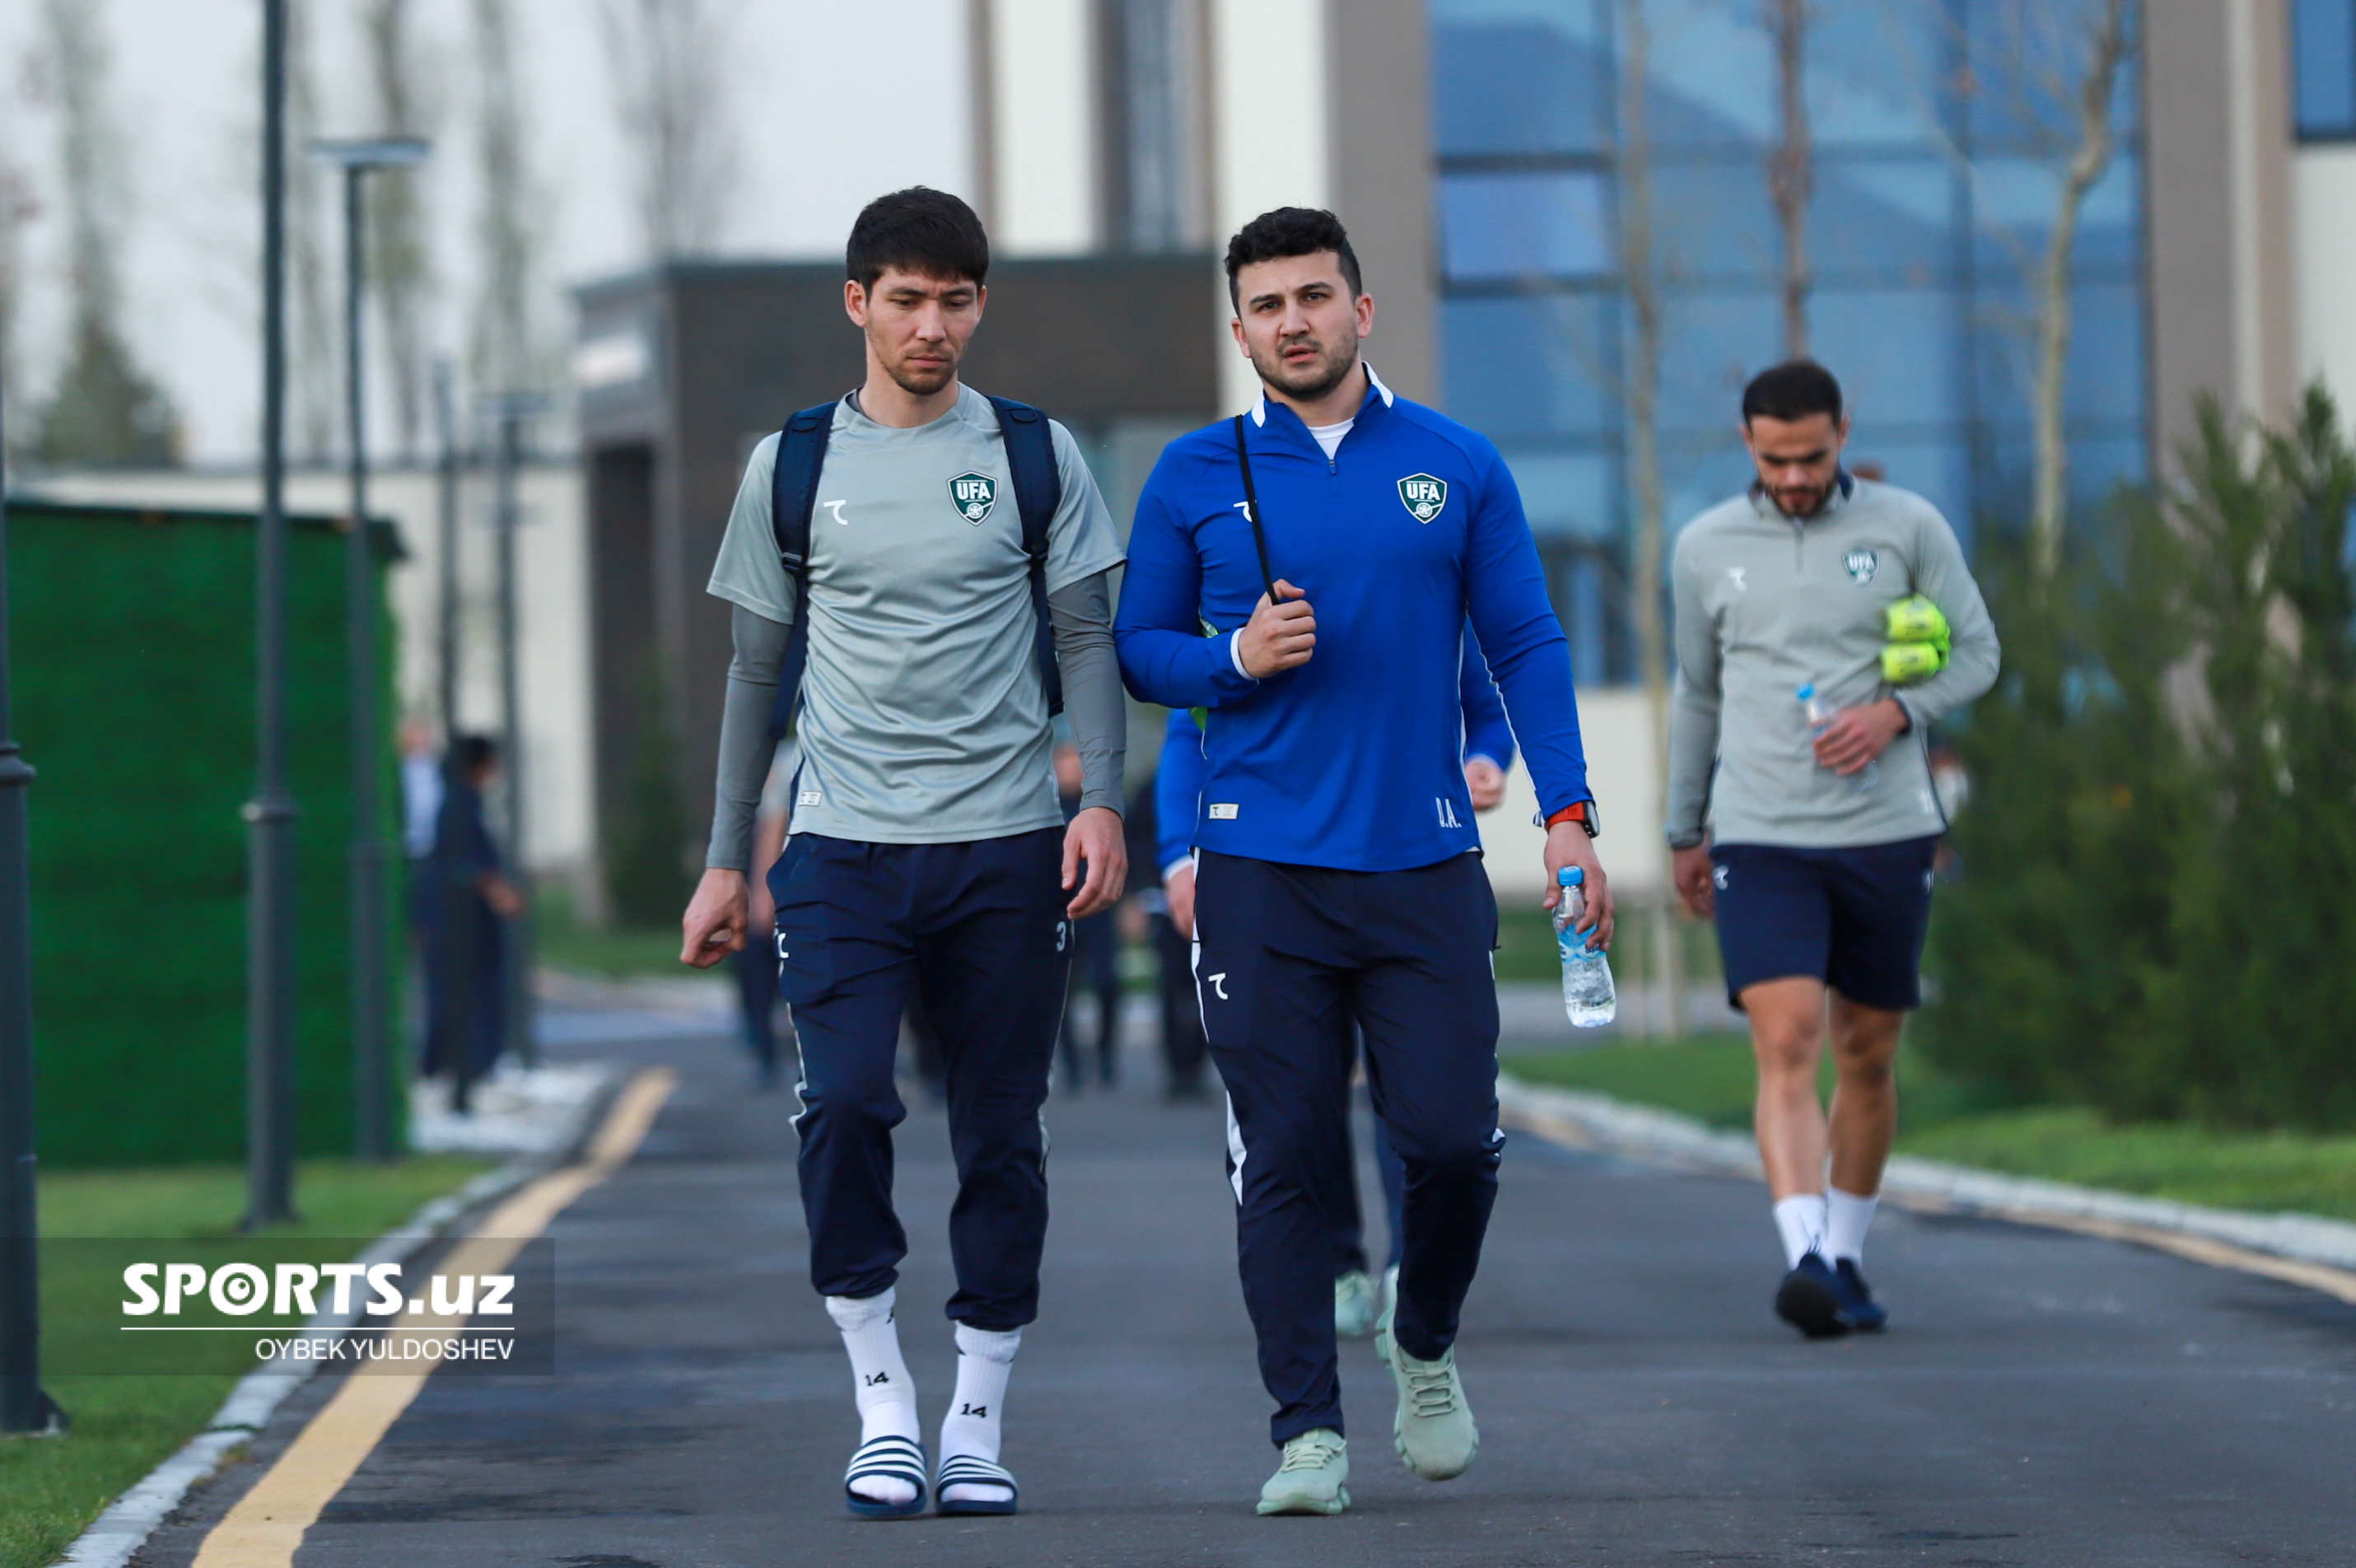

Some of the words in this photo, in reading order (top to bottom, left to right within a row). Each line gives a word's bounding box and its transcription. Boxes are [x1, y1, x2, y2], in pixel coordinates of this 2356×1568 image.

[956, 483, 991, 500] UFA
[1407, 483, 1441, 501] UFA
[1849, 553, 1875, 571] UFA
[1056, 922, 1066, 952] 3
[865, 1371, 889, 1387] 14
[960, 1402, 988, 1418] 14
